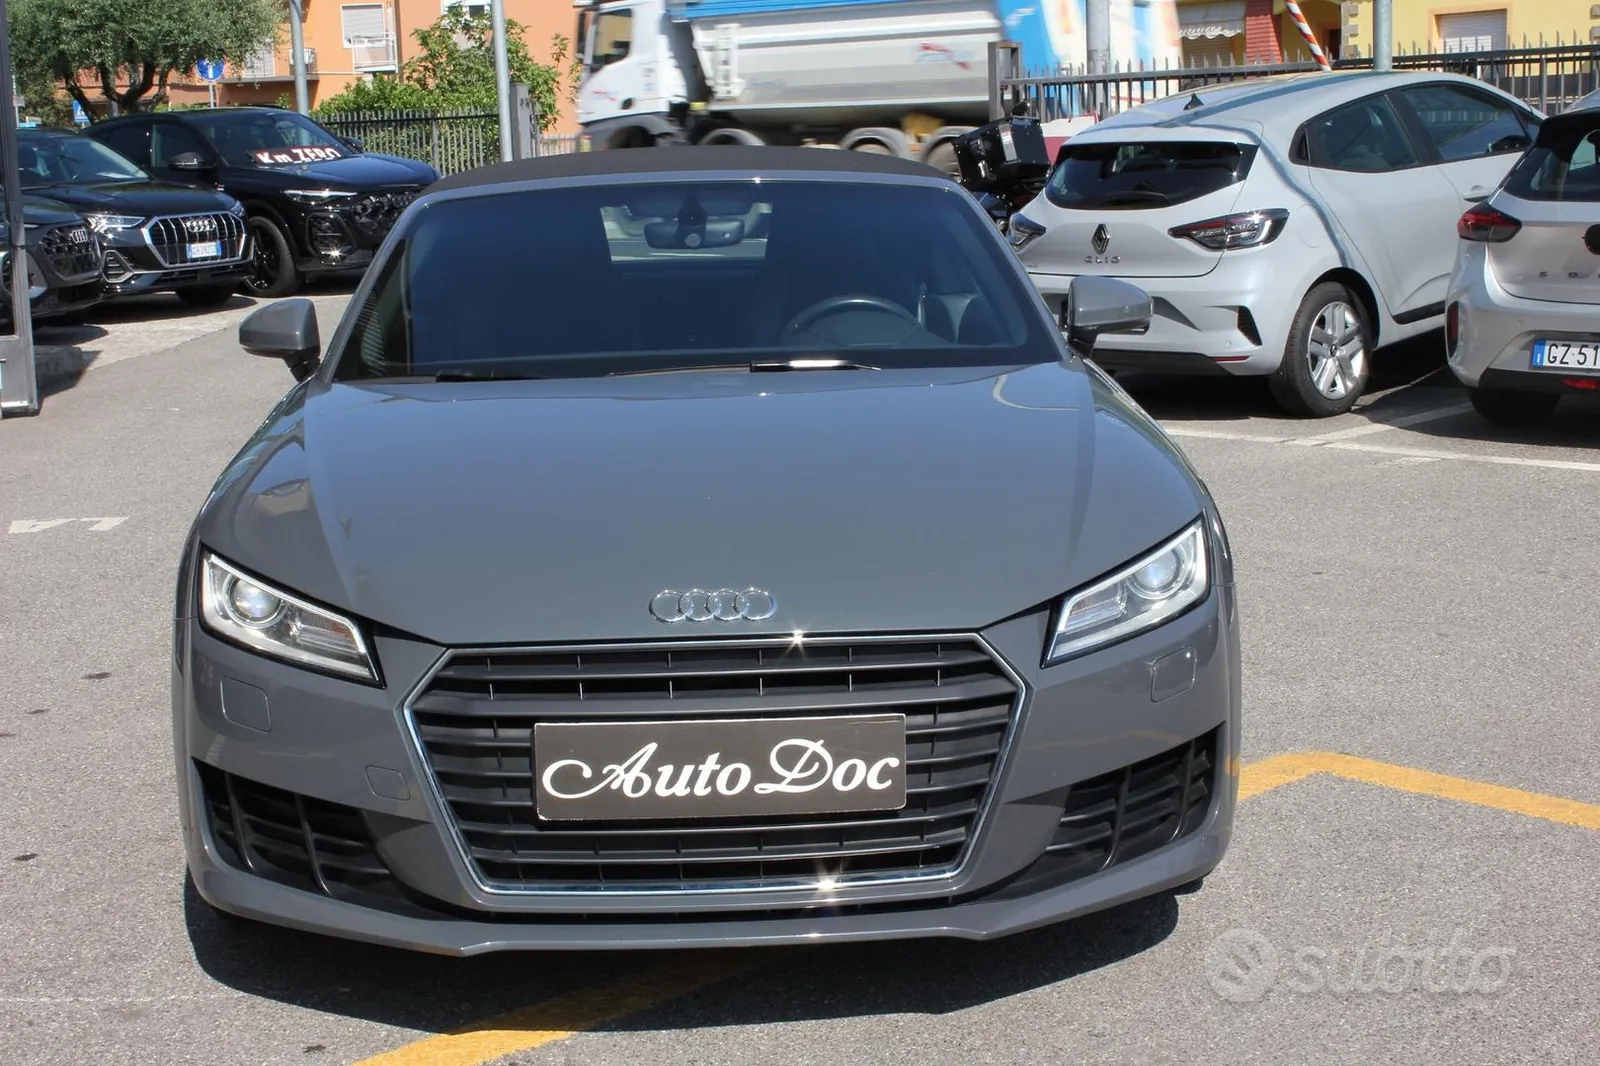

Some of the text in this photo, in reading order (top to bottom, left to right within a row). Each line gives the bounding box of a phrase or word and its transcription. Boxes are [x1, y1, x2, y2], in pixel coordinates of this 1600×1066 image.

[1085, 256, 1120, 264] CLIO
[542, 738, 900, 799] Auto Doc
